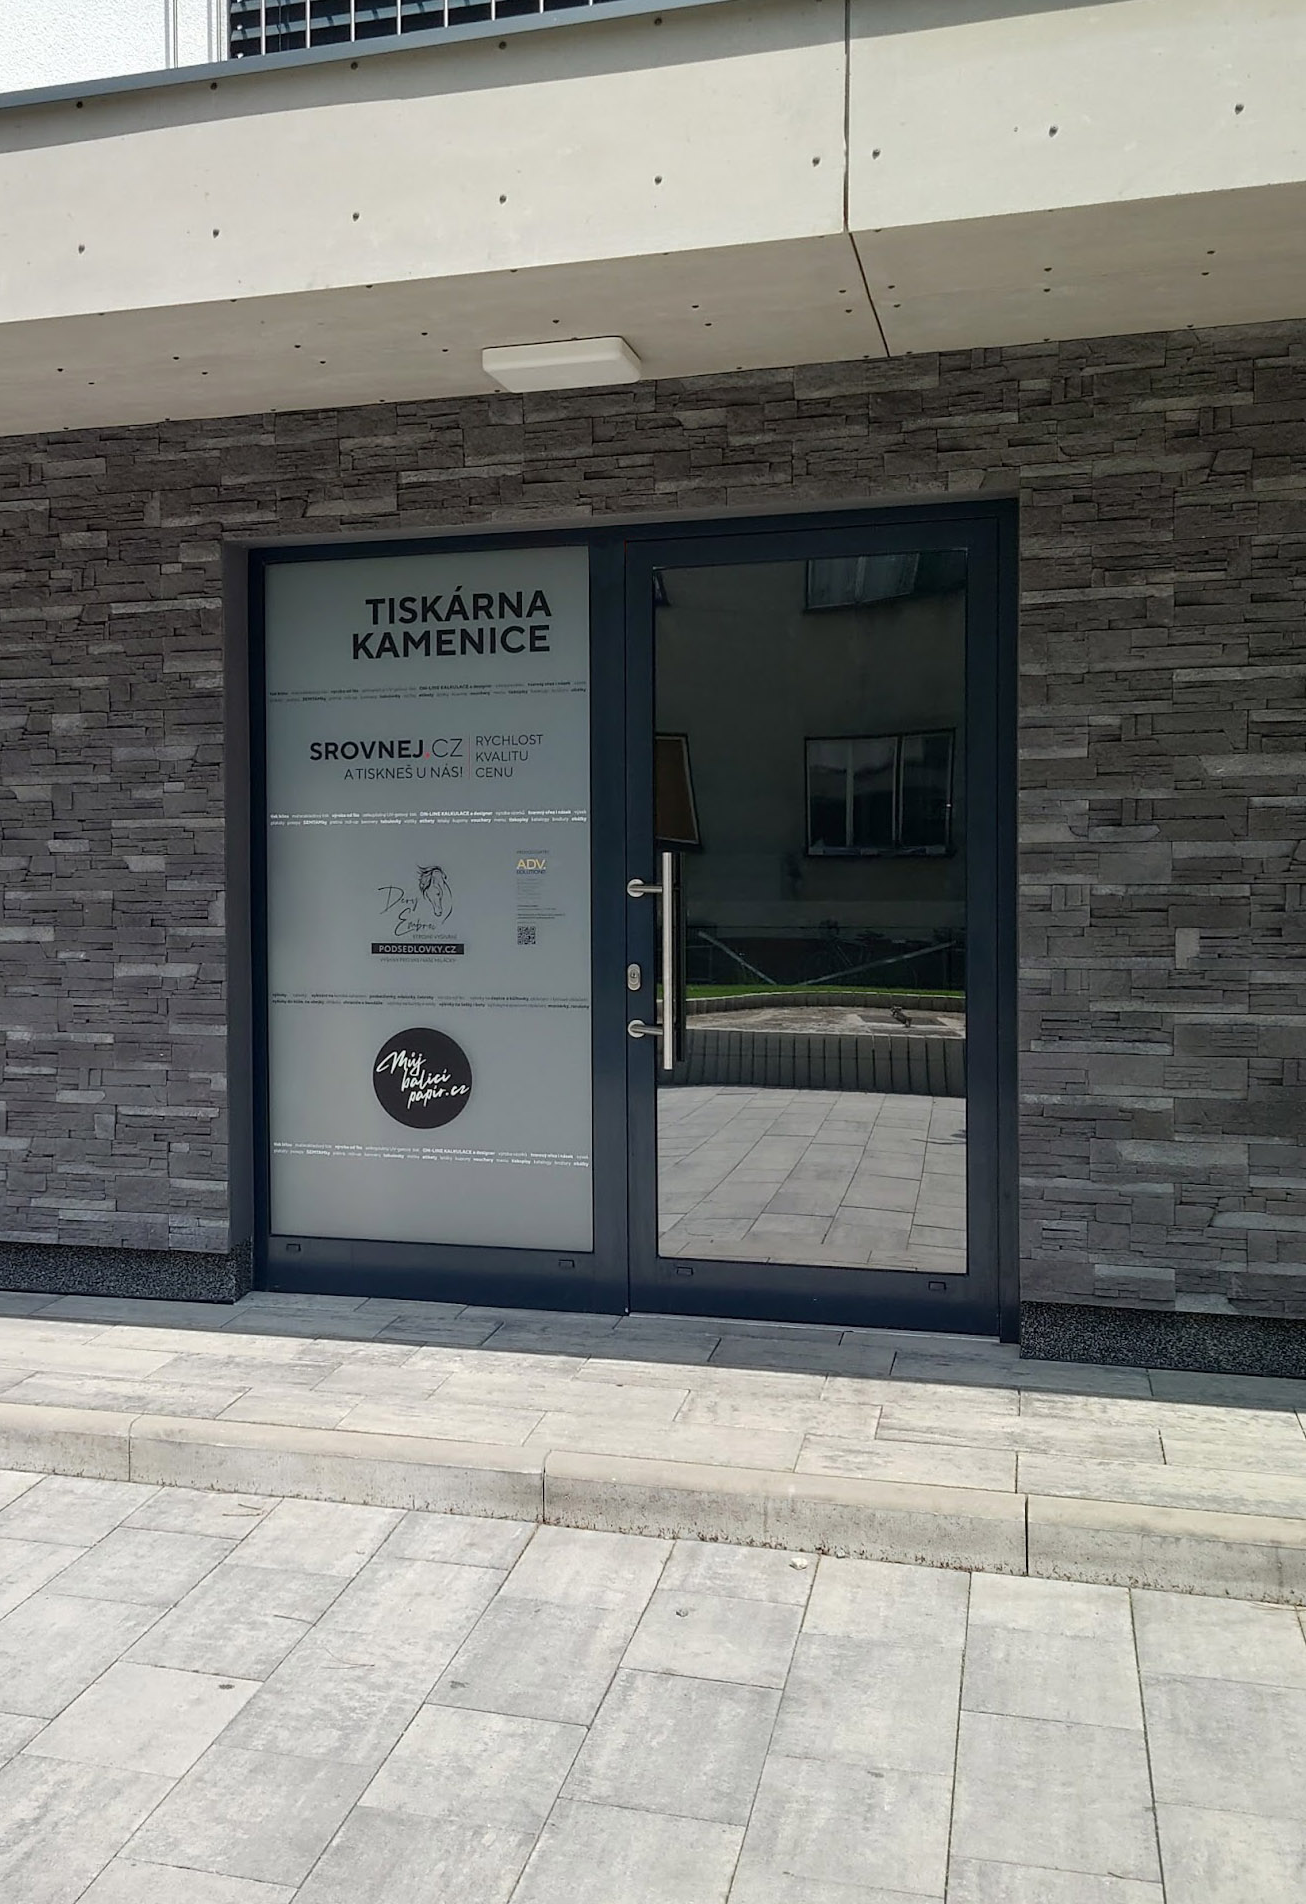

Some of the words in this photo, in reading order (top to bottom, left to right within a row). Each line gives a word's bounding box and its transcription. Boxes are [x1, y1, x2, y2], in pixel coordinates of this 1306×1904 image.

[365, 585, 552, 625] TISKÁRNA
[353, 625, 550, 660] KAMENICE
[475, 735, 543, 746] RYCHLOST
[309, 738, 463, 761] SROVNEJ.CZ
[475, 751, 529, 762] KVALITU
[416, 767, 426, 779] U
[430, 763, 463, 778] NÁS!
[475, 767, 513, 778] CENU
[378, 945, 457, 954] PODSEDLOVKY.CZ
